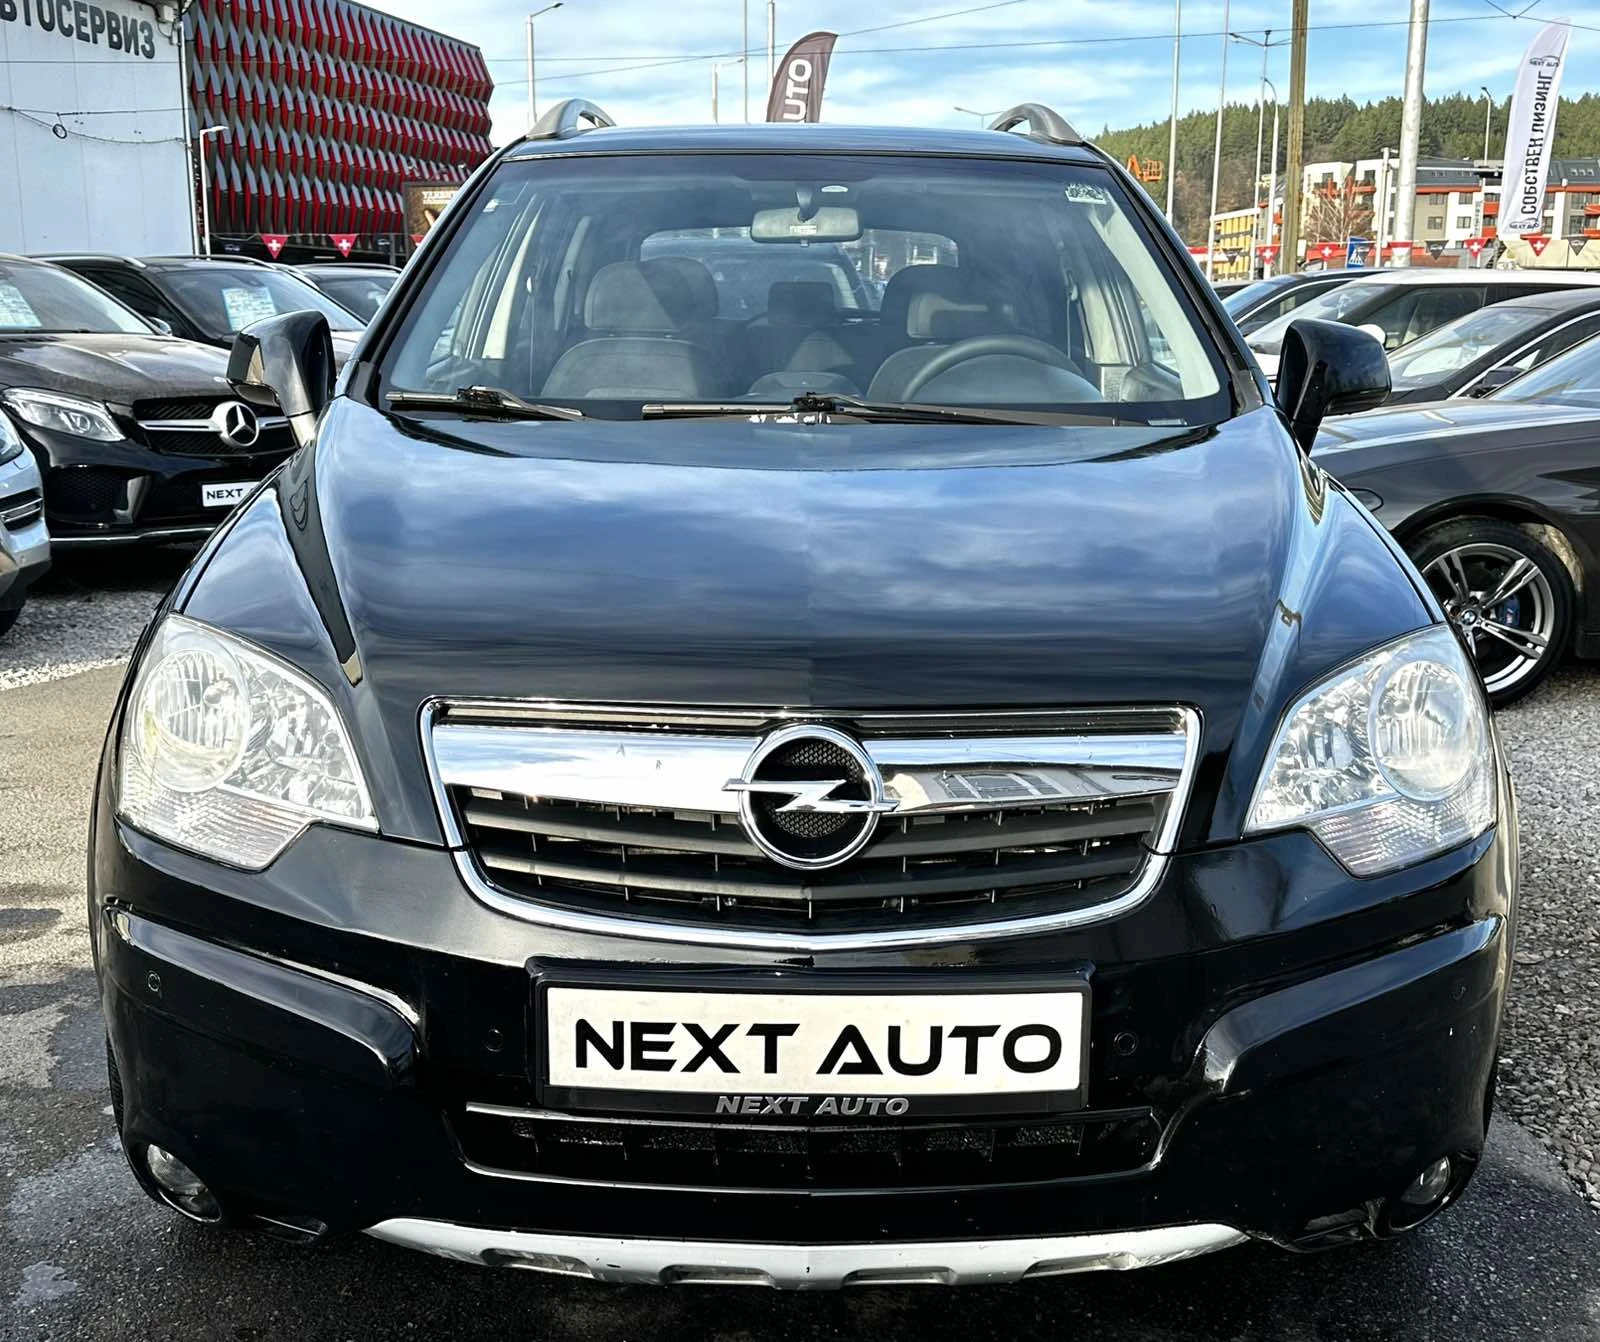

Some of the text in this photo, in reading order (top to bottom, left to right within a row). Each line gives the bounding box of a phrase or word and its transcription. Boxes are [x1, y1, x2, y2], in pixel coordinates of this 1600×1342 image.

[783, 58, 812, 121] UTO
[1521, 71, 1554, 214] СОБСТВЕН ЛИЗИНГ
[207, 488, 243, 499] NEXT
[575, 1018, 1062, 1077] NEXT AUTO
[715, 1096, 910, 1116] NEXT AUTO
